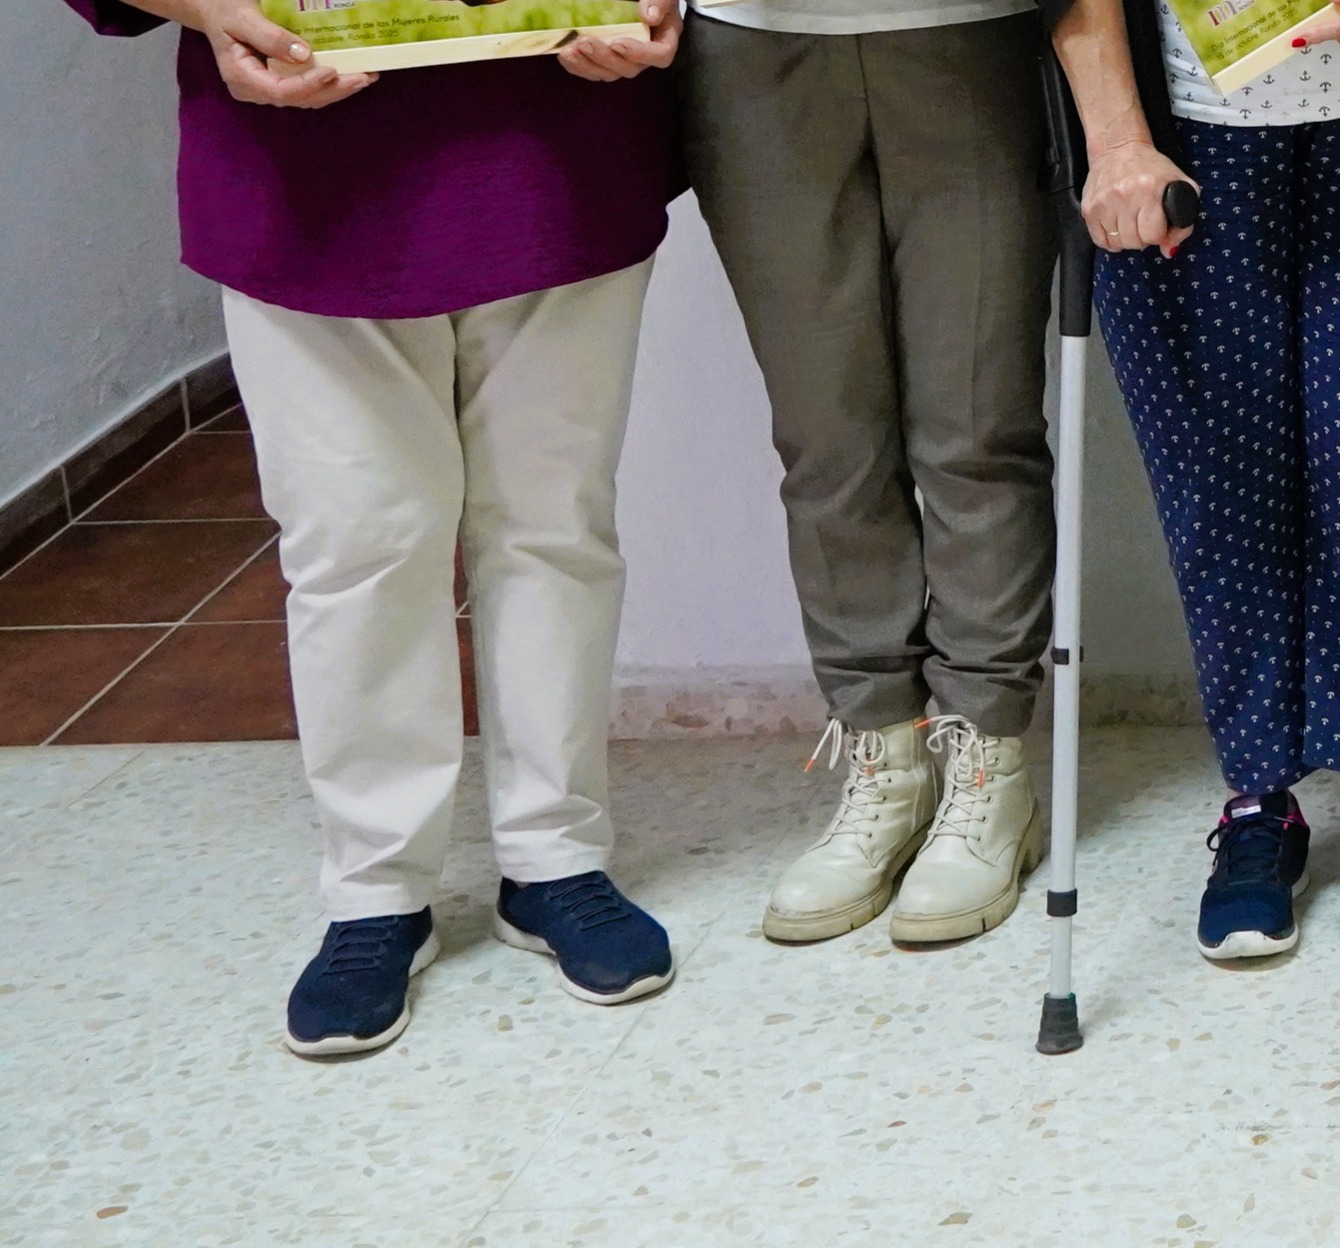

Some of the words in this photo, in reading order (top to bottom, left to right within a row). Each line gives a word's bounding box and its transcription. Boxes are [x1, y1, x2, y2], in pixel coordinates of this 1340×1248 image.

[1266, 10, 1276, 18] de
[1276, 3, 1287, 12] las
[391, 17, 426, 26] Mujeres
[427, 14, 460, 22] Rurales
